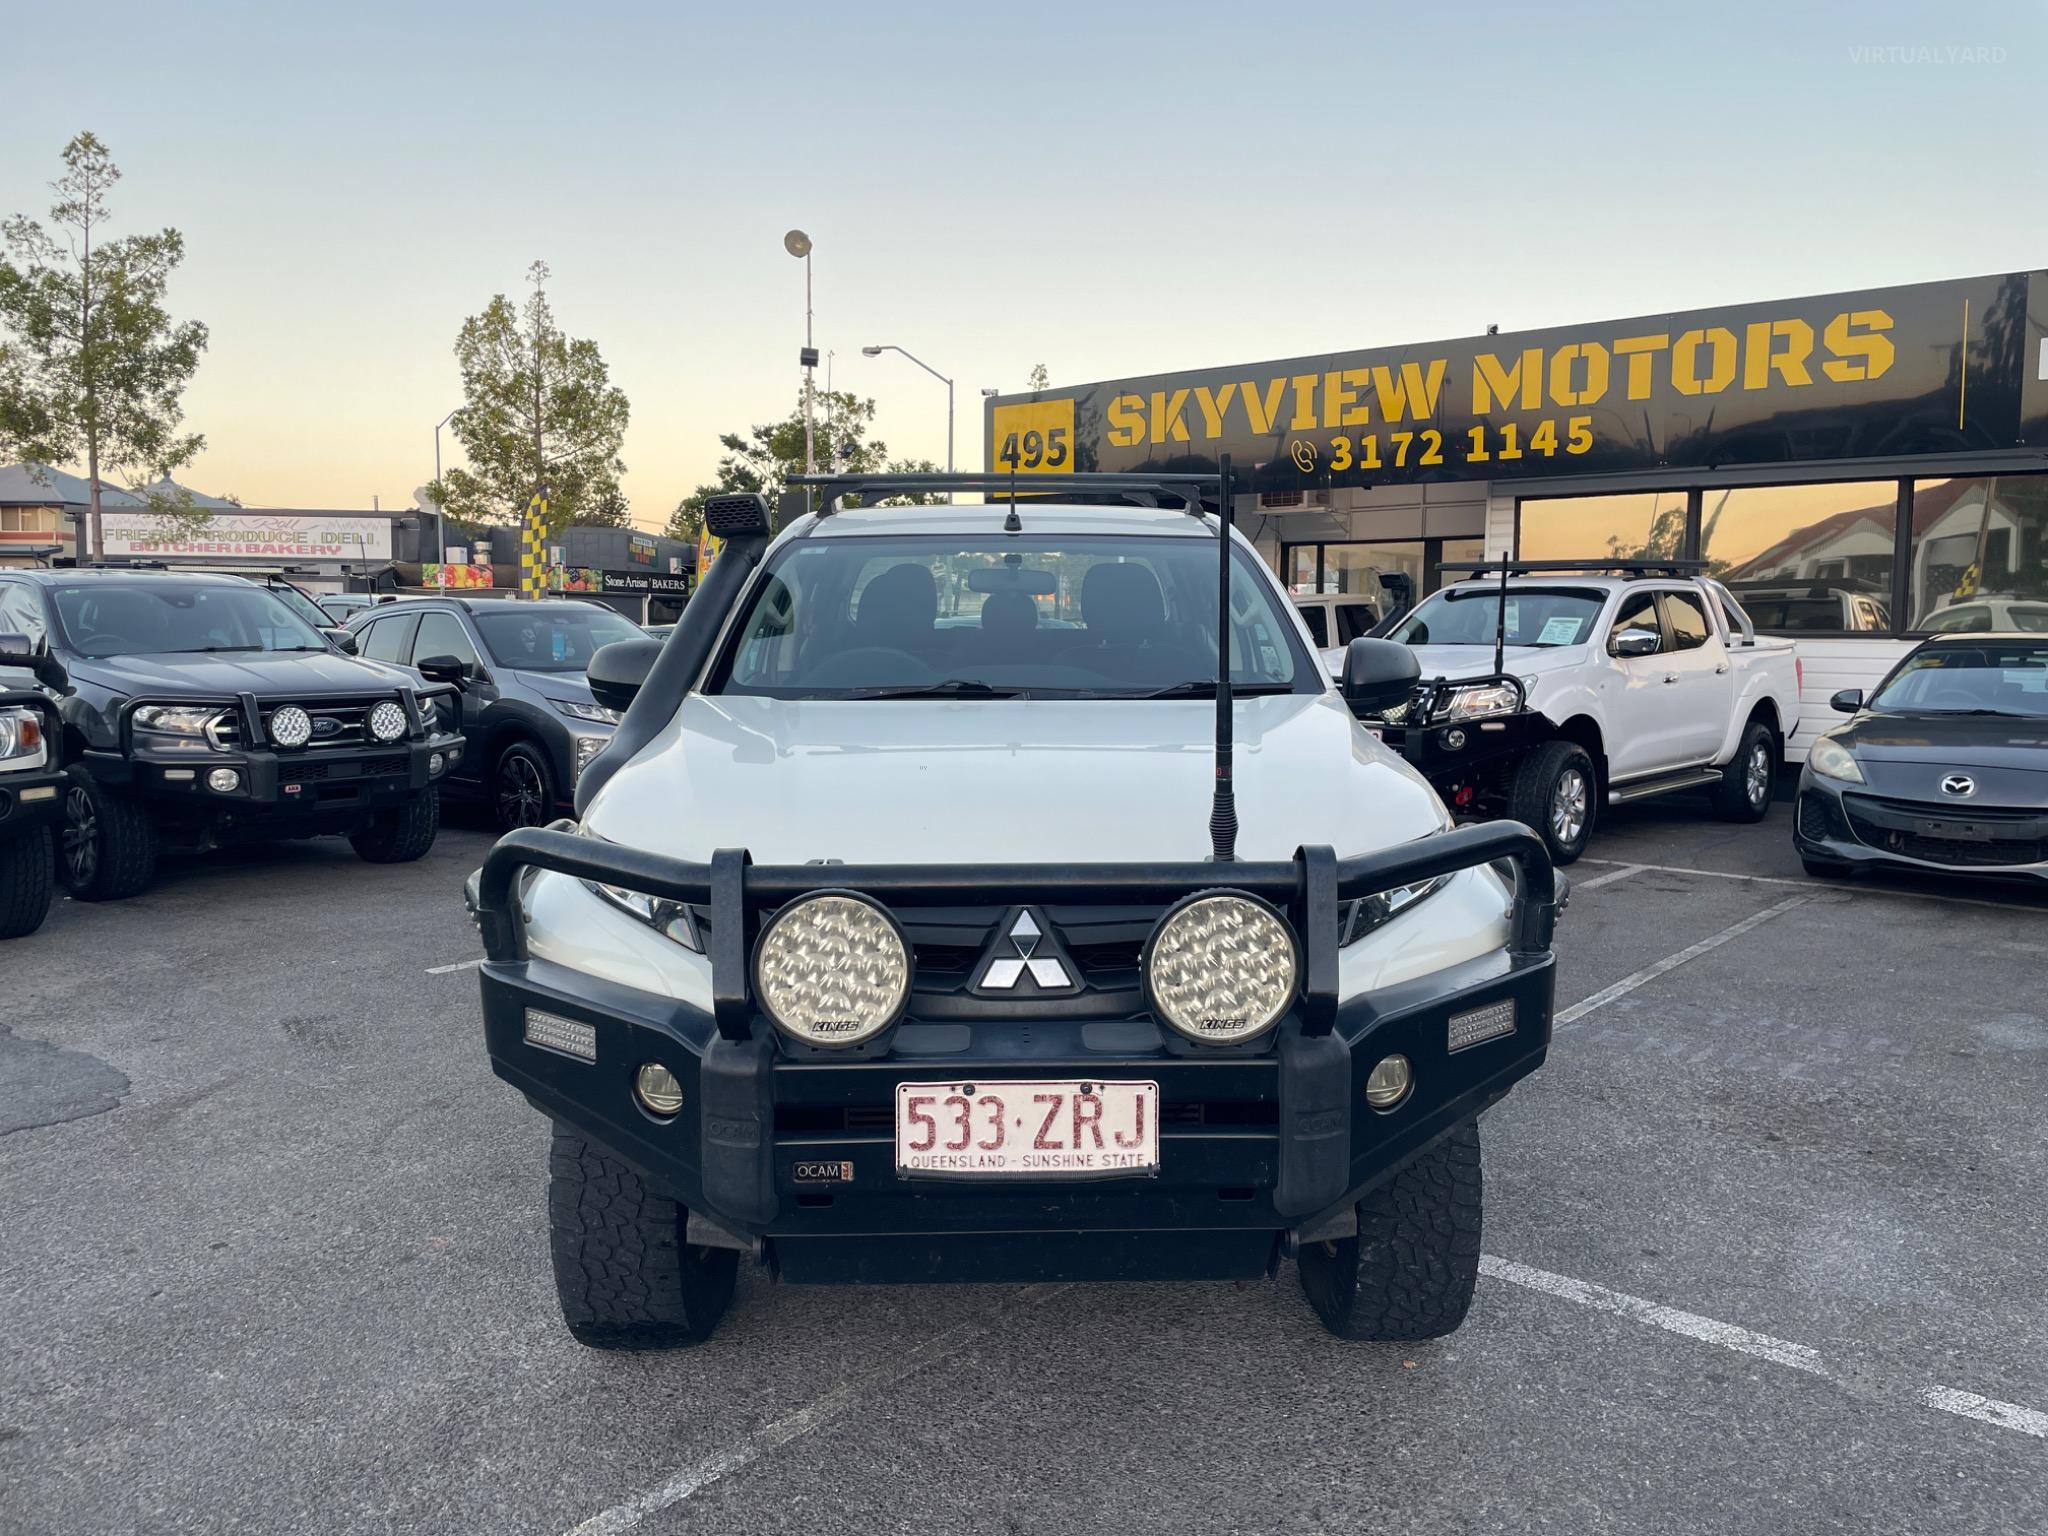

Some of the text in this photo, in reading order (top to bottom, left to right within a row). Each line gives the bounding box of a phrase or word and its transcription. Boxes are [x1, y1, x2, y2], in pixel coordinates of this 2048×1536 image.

[1106, 309, 1896, 447] SKYVIEW MOTORS
[999, 427, 1068, 470] 495
[1329, 415, 1594, 471] 3172 1145
[130, 541, 232, 554] BUTCHER
[245, 542, 342, 555] BAKERY
[605, 574, 686, 590] Stone Artisan BAKERS
[811, 1021, 860, 1032] KINGS
[1200, 1019, 1247, 1030] KINGS
[908, 1093, 1145, 1151] 533 ZRJ
[911, 1155, 1005, 1168] QUEENSLAND
[1022, 1154, 1094, 1168] SUNSHINE
[1101, 1153, 1146, 1167] STATE
[798, 1165, 839, 1177] OCAM
